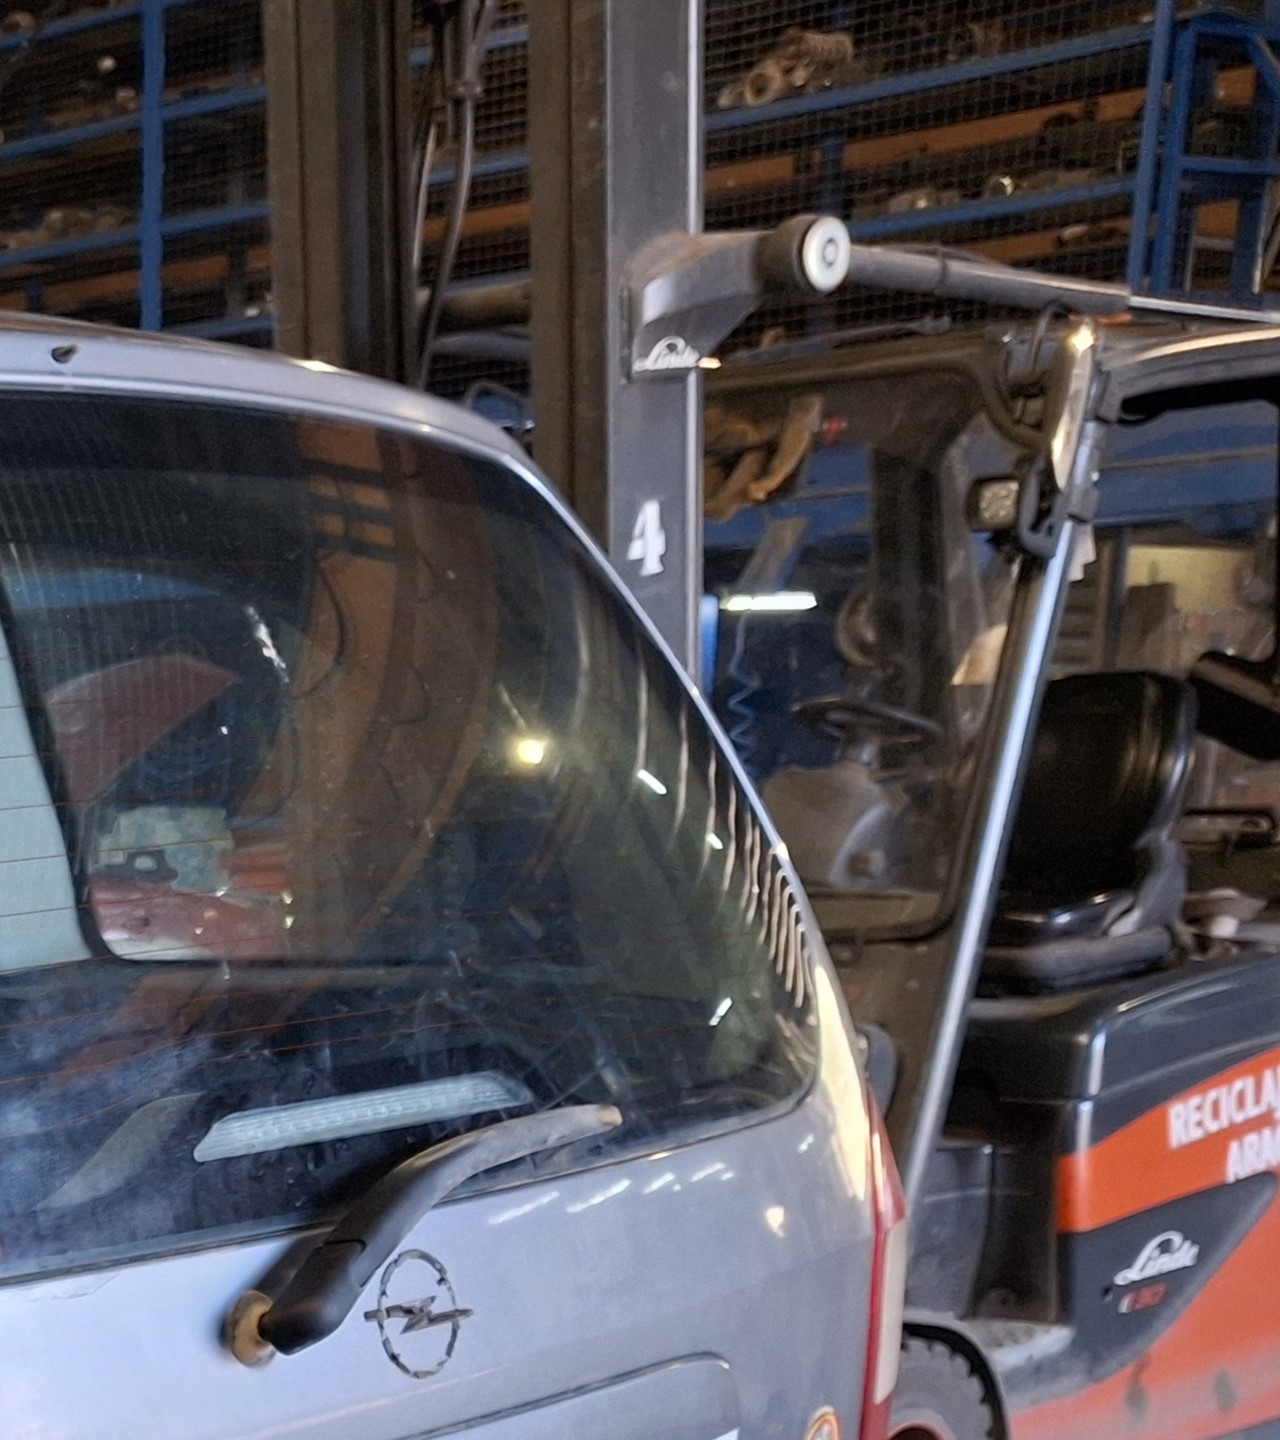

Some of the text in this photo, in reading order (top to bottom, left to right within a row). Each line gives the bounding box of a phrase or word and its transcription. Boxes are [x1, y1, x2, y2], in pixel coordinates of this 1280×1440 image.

[626, 499, 666, 577] 4
[1168, 1064, 1280, 1150] RECICLA
[1225, 1122, 1280, 1184] ARA
